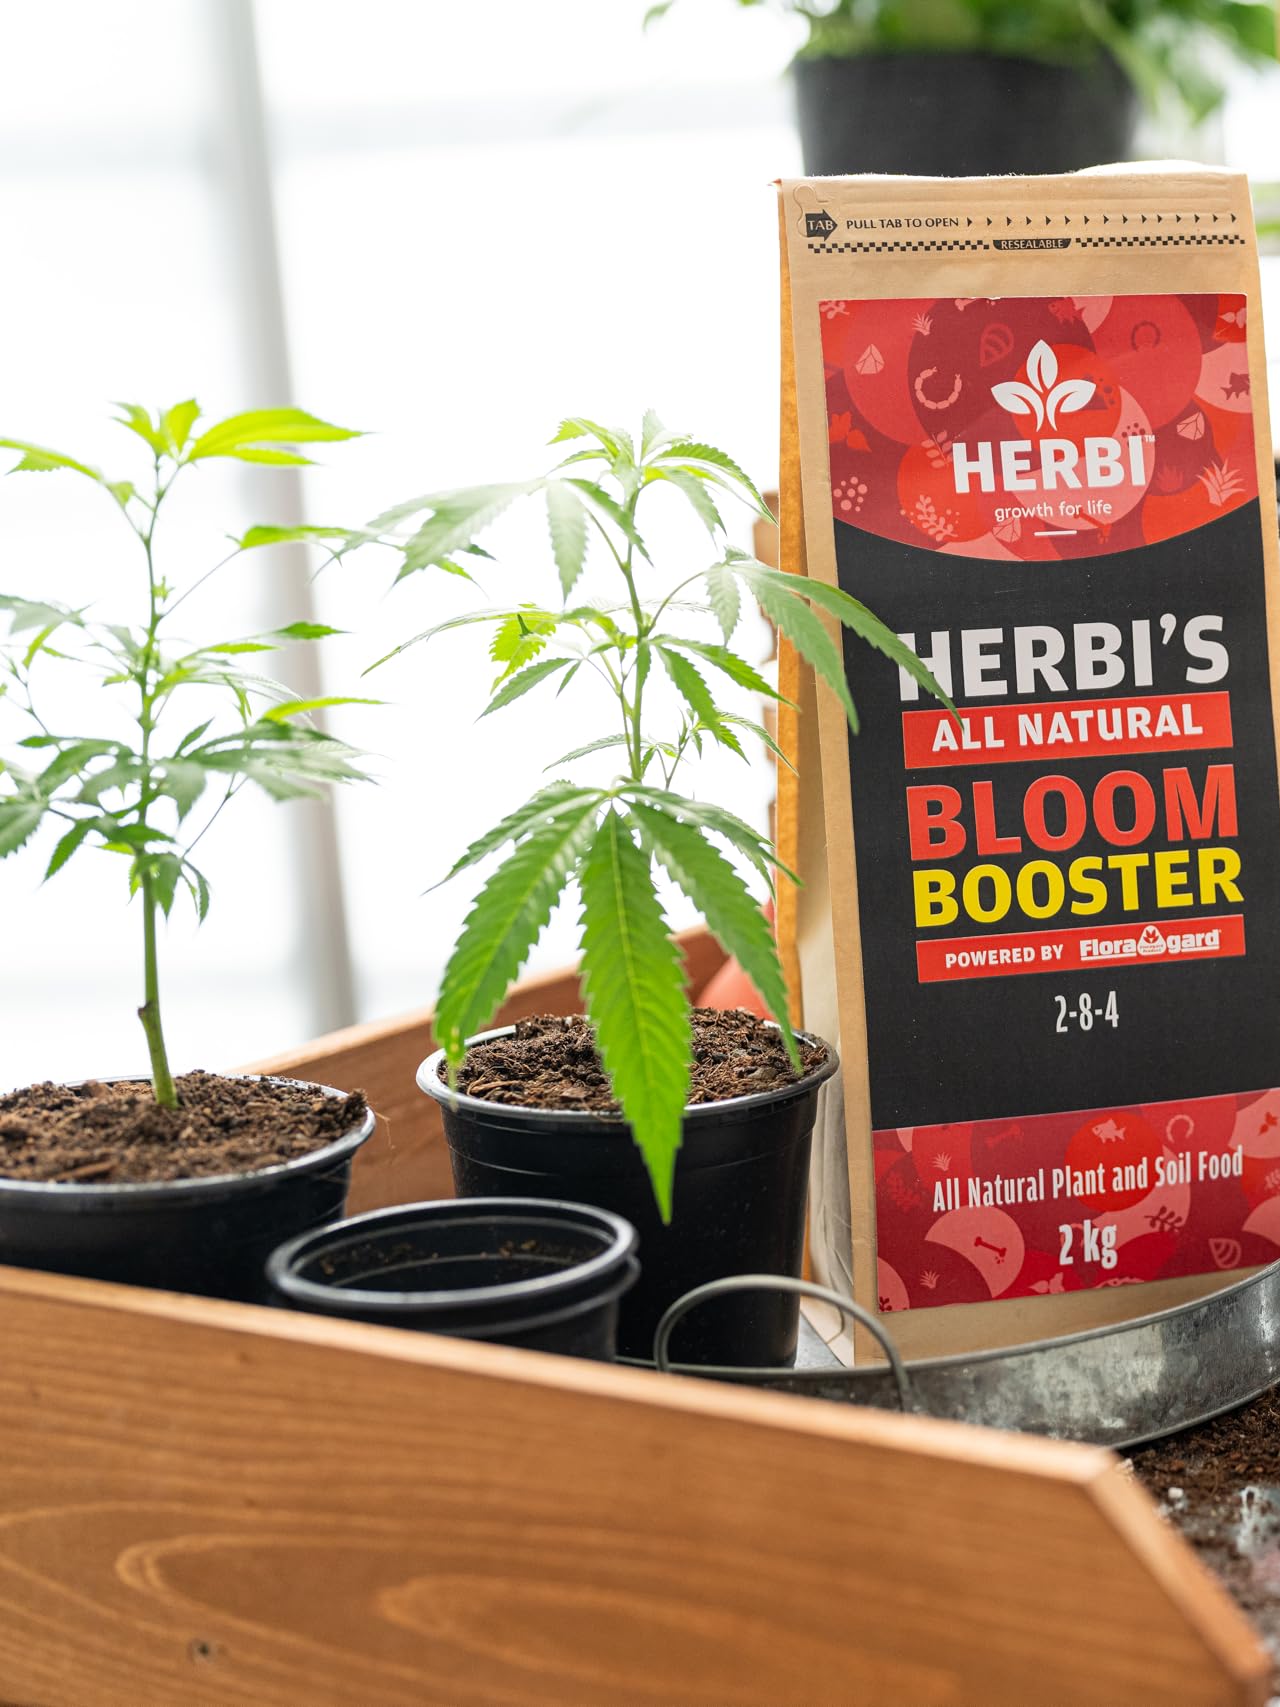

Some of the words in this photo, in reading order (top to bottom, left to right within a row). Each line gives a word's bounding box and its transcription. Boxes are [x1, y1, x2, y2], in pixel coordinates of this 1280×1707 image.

[807, 220, 834, 231] TAB
[846, 219, 877, 229] PULL
[879, 218, 902, 229] TAB
[904, 218, 922, 228] TO
[925, 217, 959, 228] OPEN
[1001, 239, 1064, 250] RESEALABLE
[952, 435, 1146, 494] HERBI
[994, 500, 1053, 521] growth
[1058, 501, 1084, 517] for
[1087, 499, 1113, 515] life
[931, 716, 1005, 752] ALL
[1018, 703, 1203, 746] NATURAL
[906, 764, 1239, 861] BLOOM
[912, 847, 1245, 928] BOOSTER
[945, 947, 1035, 969] POWERED
[1041, 943, 1064, 961] BY
[1055, 991, 1119, 1032] 2-8-4
[932, 1177, 960, 1213] All
[968, 1168, 1044, 1208] Natural
[1052, 1160, 1105, 1199] Plant
[1112, 1157, 1148, 1191] and
[1155, 1150, 1191, 1187] Soil
[1198, 1145, 1243, 1179] Food
[1059, 1224, 1073, 1266] 2
[1083, 1219, 1118, 1269] kg
